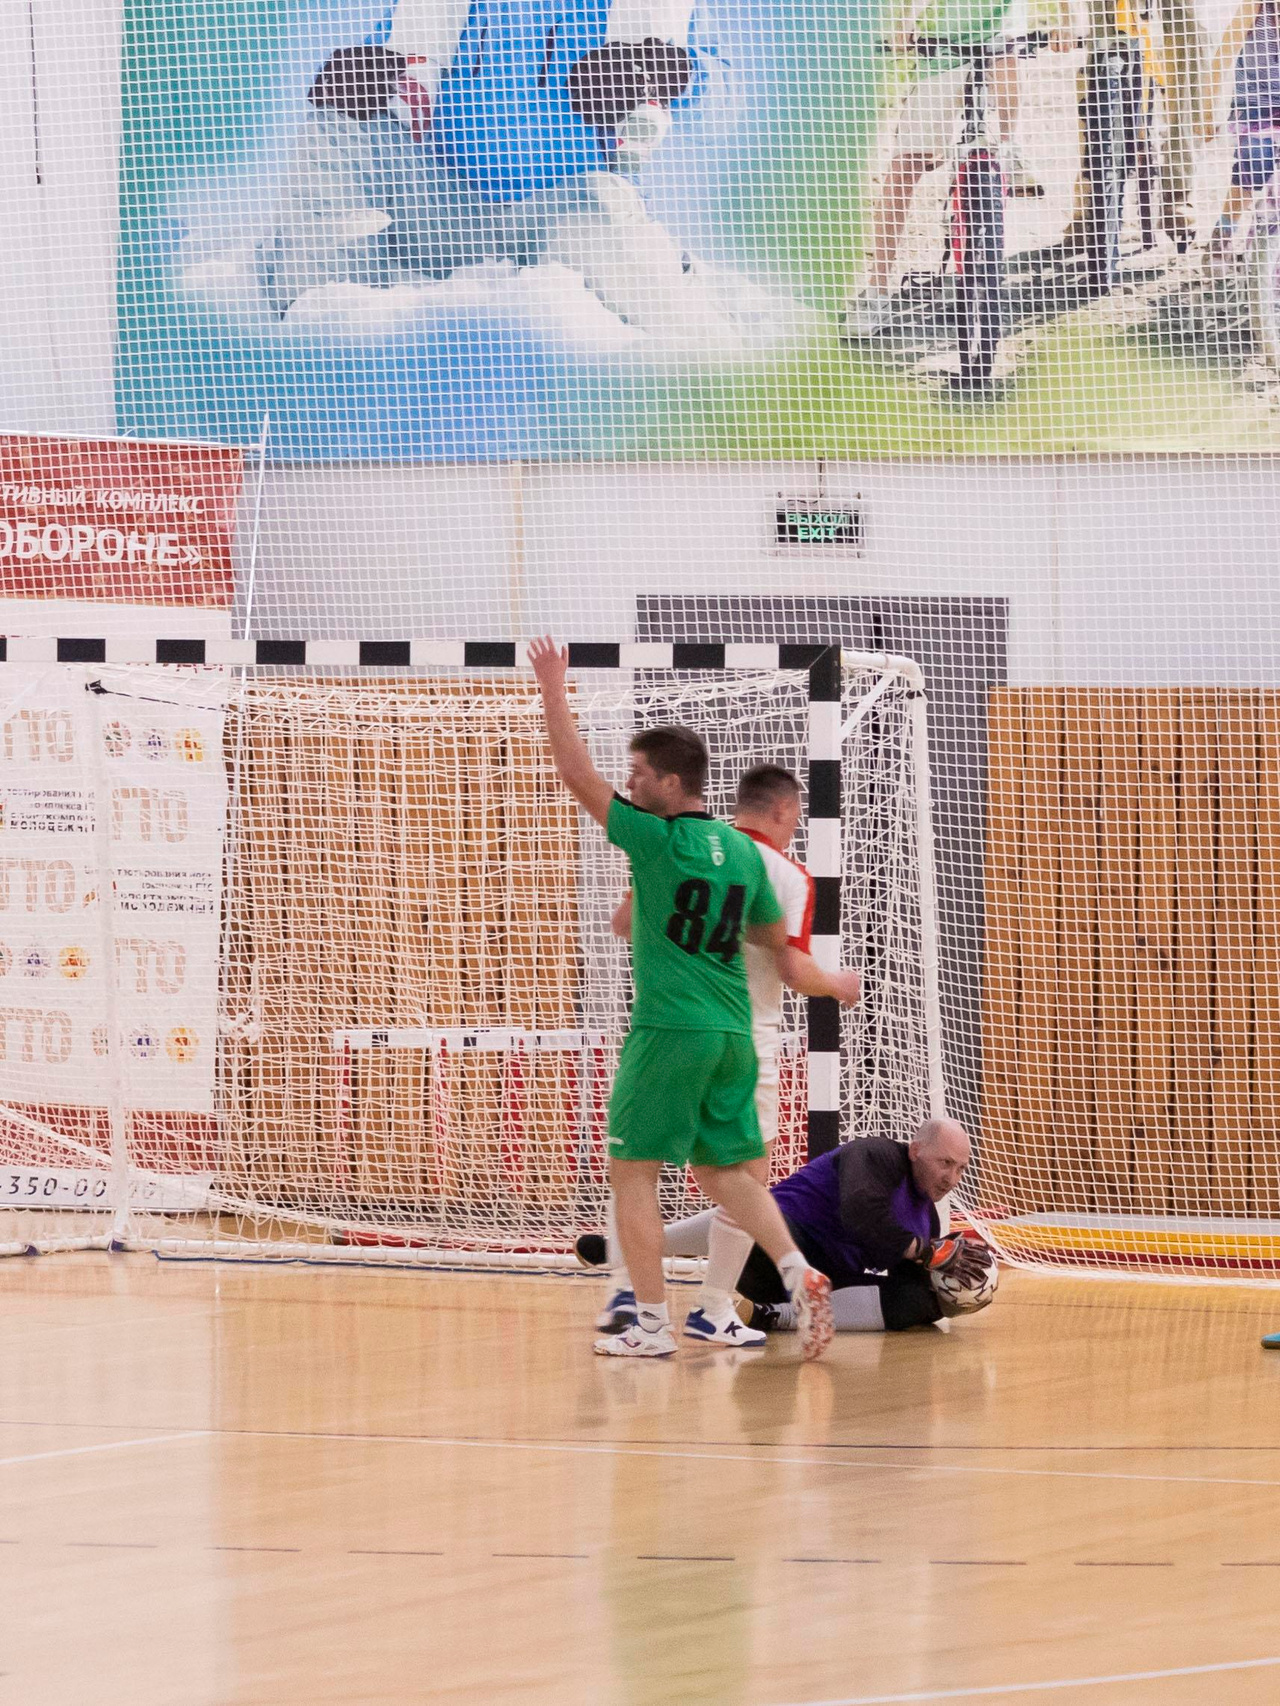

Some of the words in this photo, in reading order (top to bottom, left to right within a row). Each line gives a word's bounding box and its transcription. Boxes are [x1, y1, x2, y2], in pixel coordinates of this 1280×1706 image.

[97, 491, 205, 514] КОМПЛЕКС
[798, 527, 836, 540] EXIT
[665, 879, 747, 963] 84
